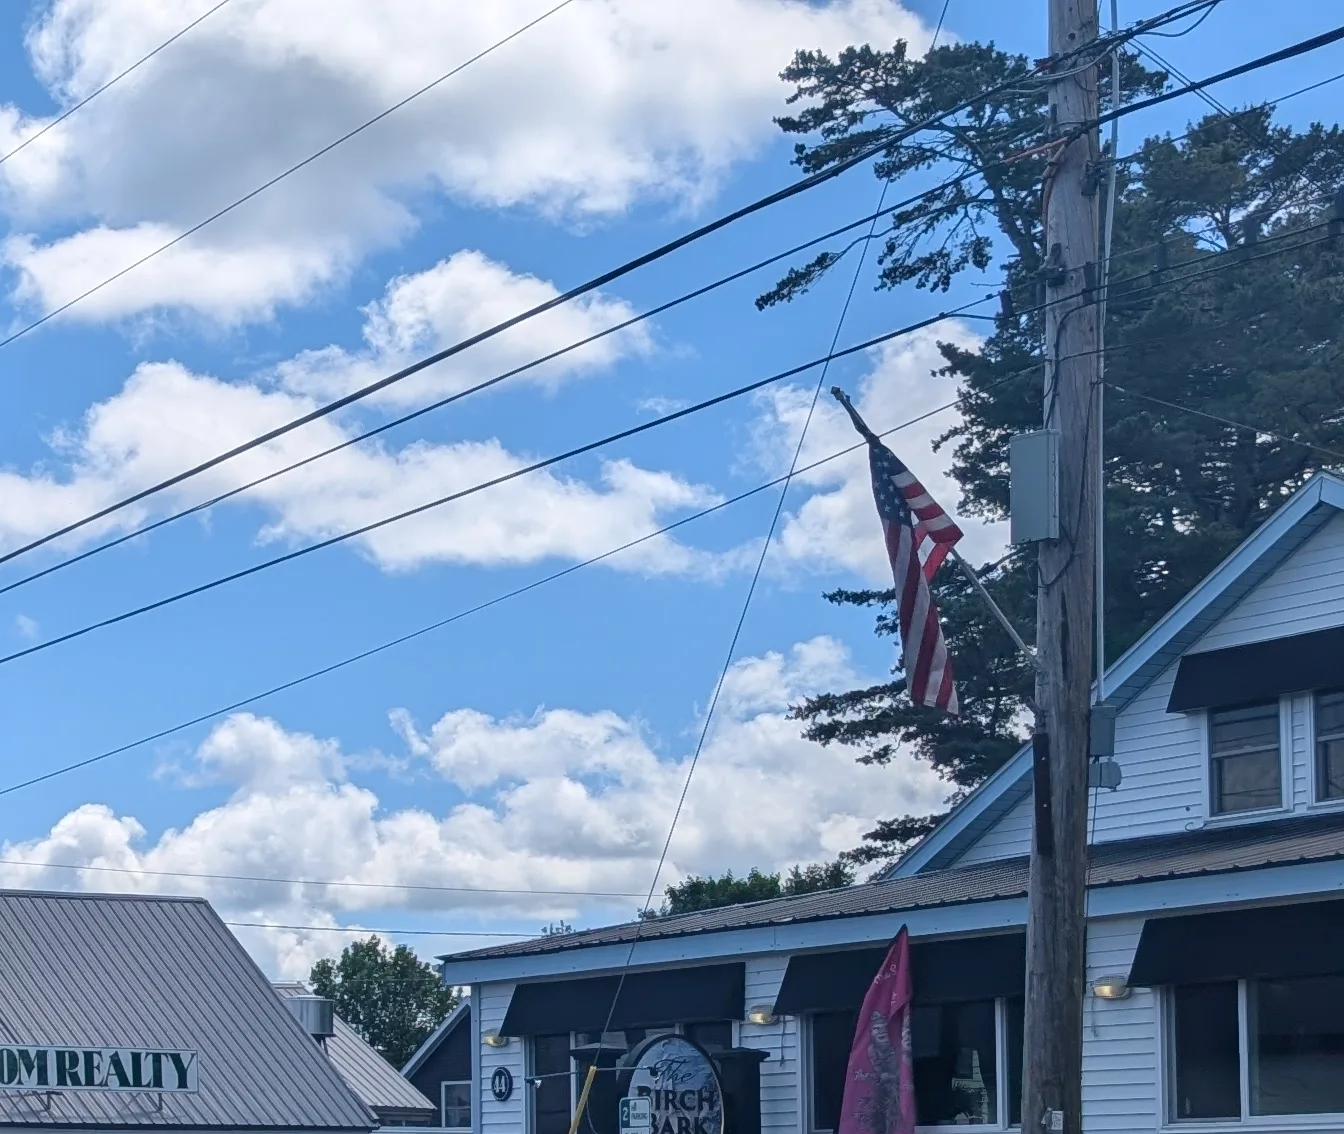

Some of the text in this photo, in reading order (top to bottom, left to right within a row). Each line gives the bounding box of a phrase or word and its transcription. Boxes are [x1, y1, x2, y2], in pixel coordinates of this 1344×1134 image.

[55, 1049, 198, 1090] REALTY
[654, 1055, 700, 1084] The
[494, 1075, 506, 1094] 44
[622, 1106, 629, 1122] 2
